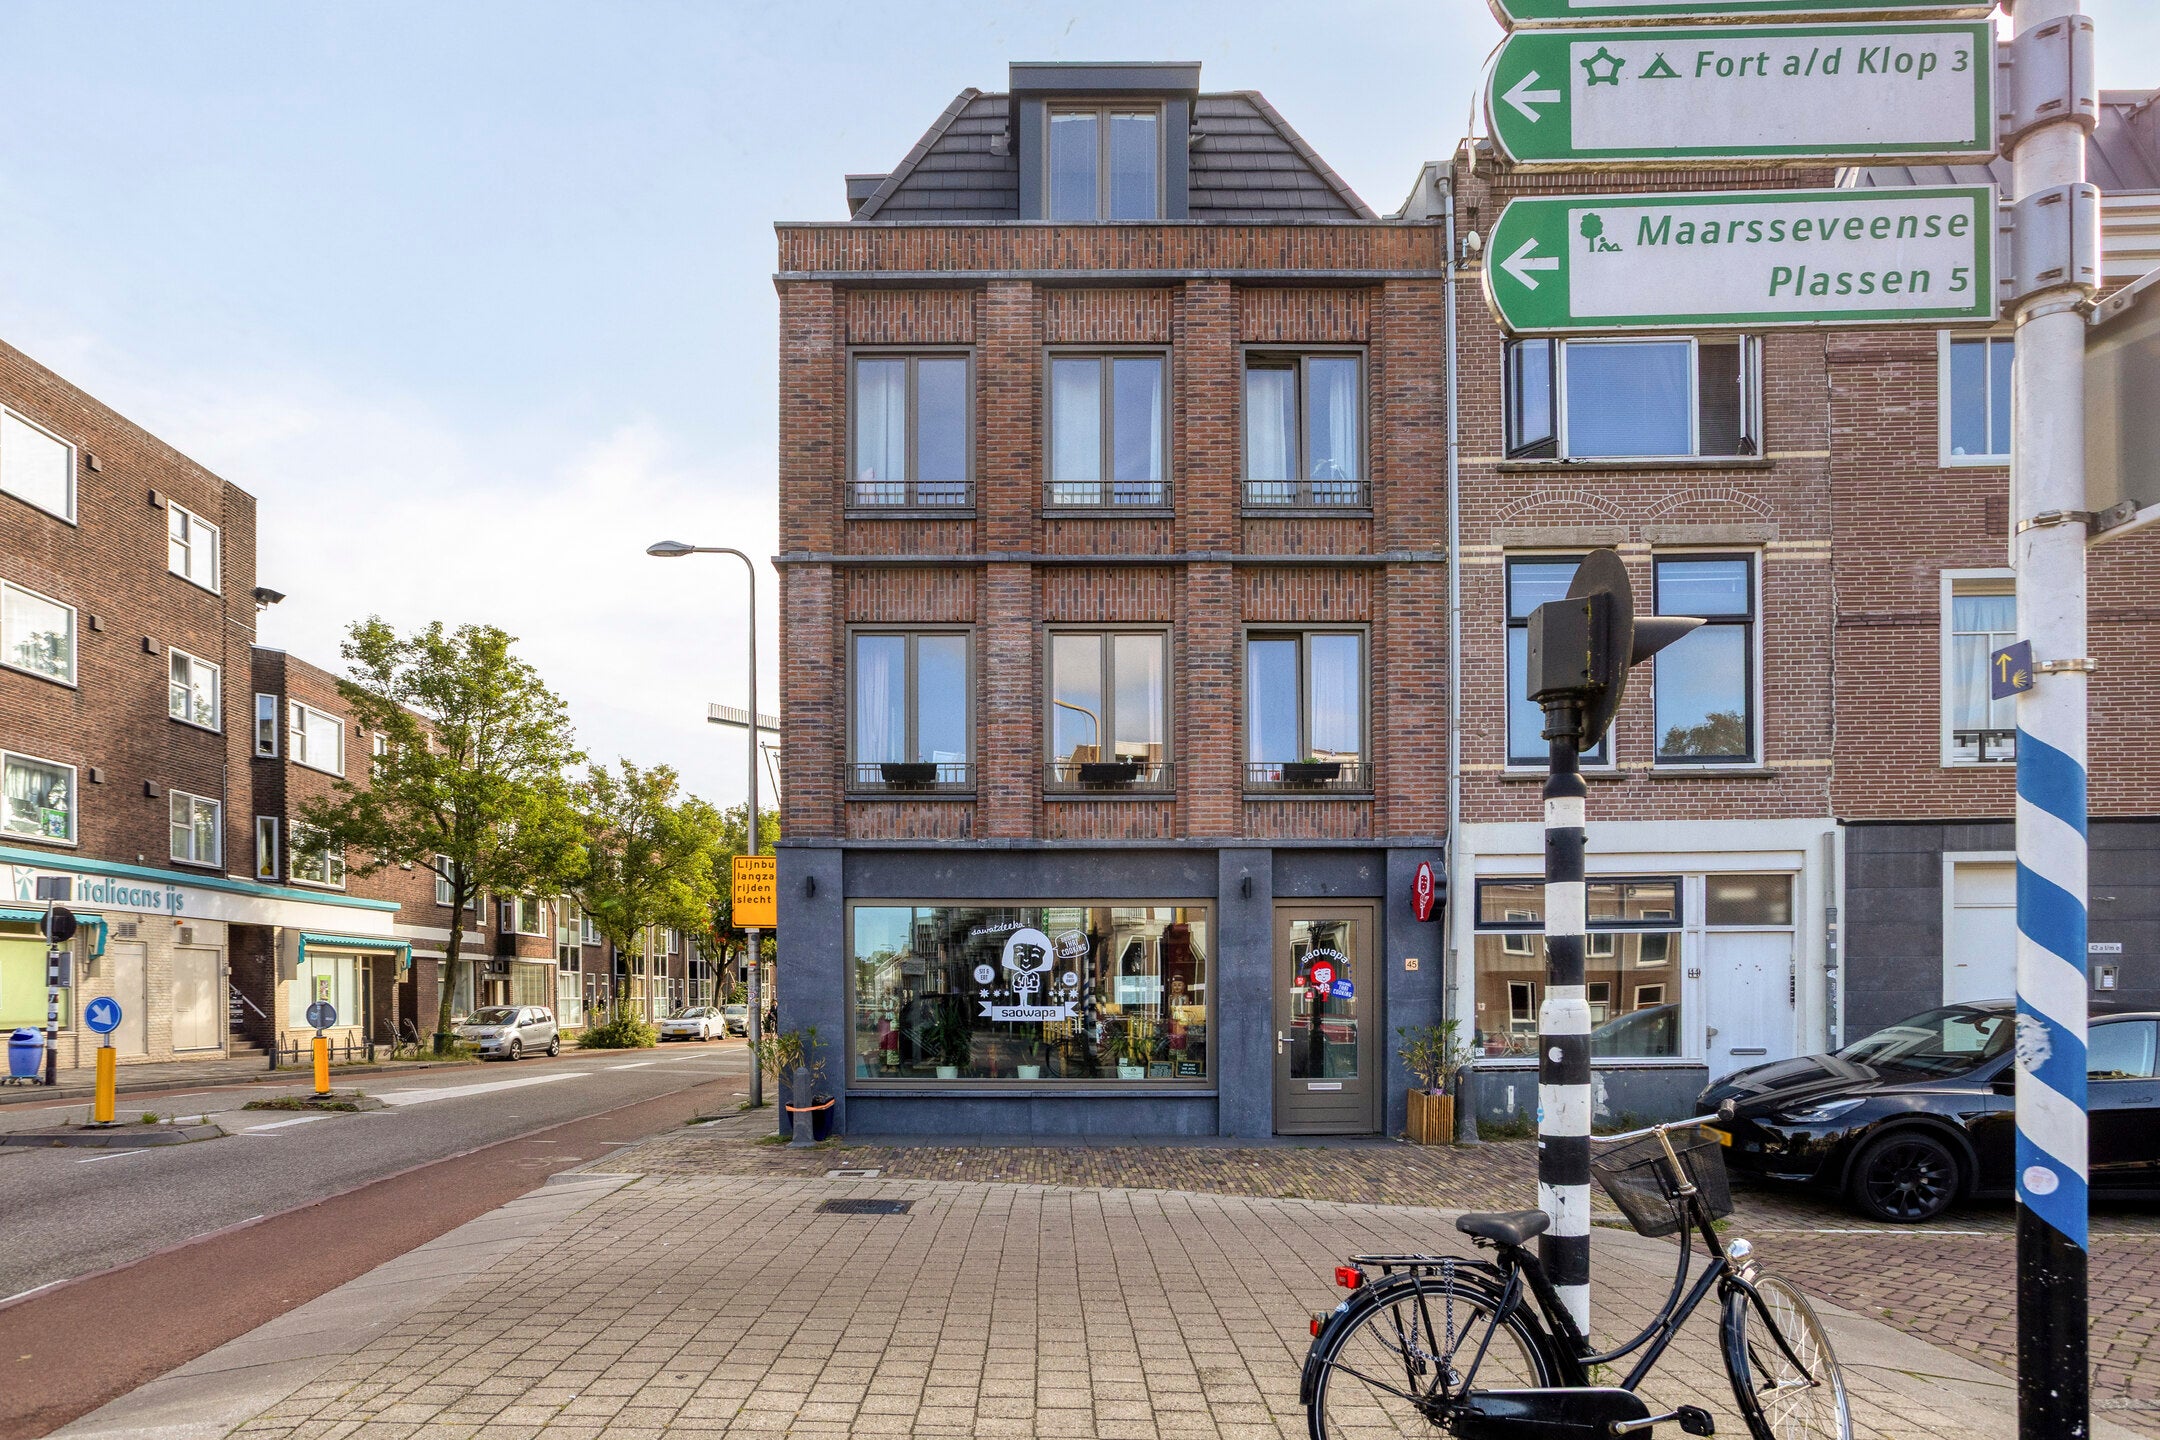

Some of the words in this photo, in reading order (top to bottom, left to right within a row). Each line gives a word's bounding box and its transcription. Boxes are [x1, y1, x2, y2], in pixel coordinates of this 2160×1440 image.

[1694, 50, 1769, 77] Fort
[1782, 46, 1841, 76] a/d
[1857, 46, 1937, 80] Klop
[1951, 50, 1969, 72] 3
[1636, 213, 1969, 245] Maarsseveense
[1768, 265, 1930, 297] Plassen
[1948, 267, 1969, 292] 5
[738, 860, 774, 870] Lijnbu
[738, 872, 774, 882] langza
[737, 884, 771, 894] rijden
[77, 874, 161, 909] italiaans
[166, 886, 184, 917] ijs
[737, 895, 772, 904] slecht
[1301, 948, 1349, 964] saowapa
[1406, 960, 1417, 969] 45
[1001, 1008, 1056, 1020] saowapa
